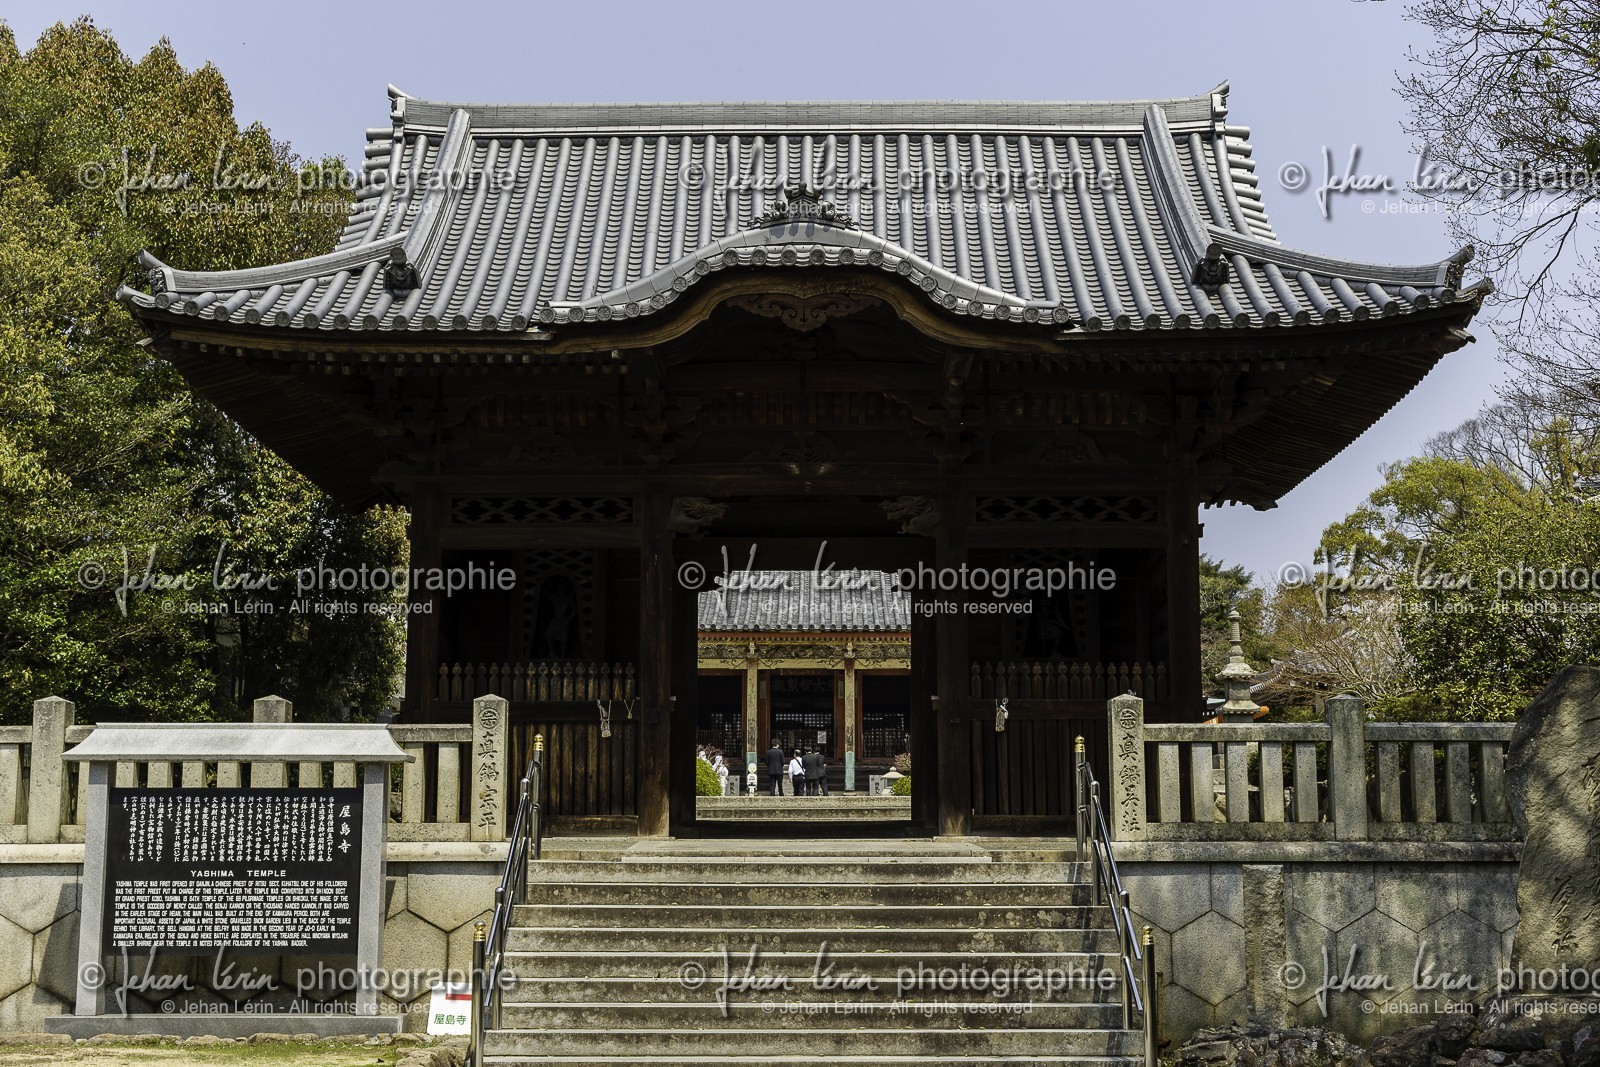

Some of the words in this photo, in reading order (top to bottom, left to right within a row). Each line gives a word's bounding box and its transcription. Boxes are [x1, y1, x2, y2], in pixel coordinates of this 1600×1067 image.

[338, 805, 351, 854] 屋島寺
[434, 1014, 466, 1025] 屋島寺
